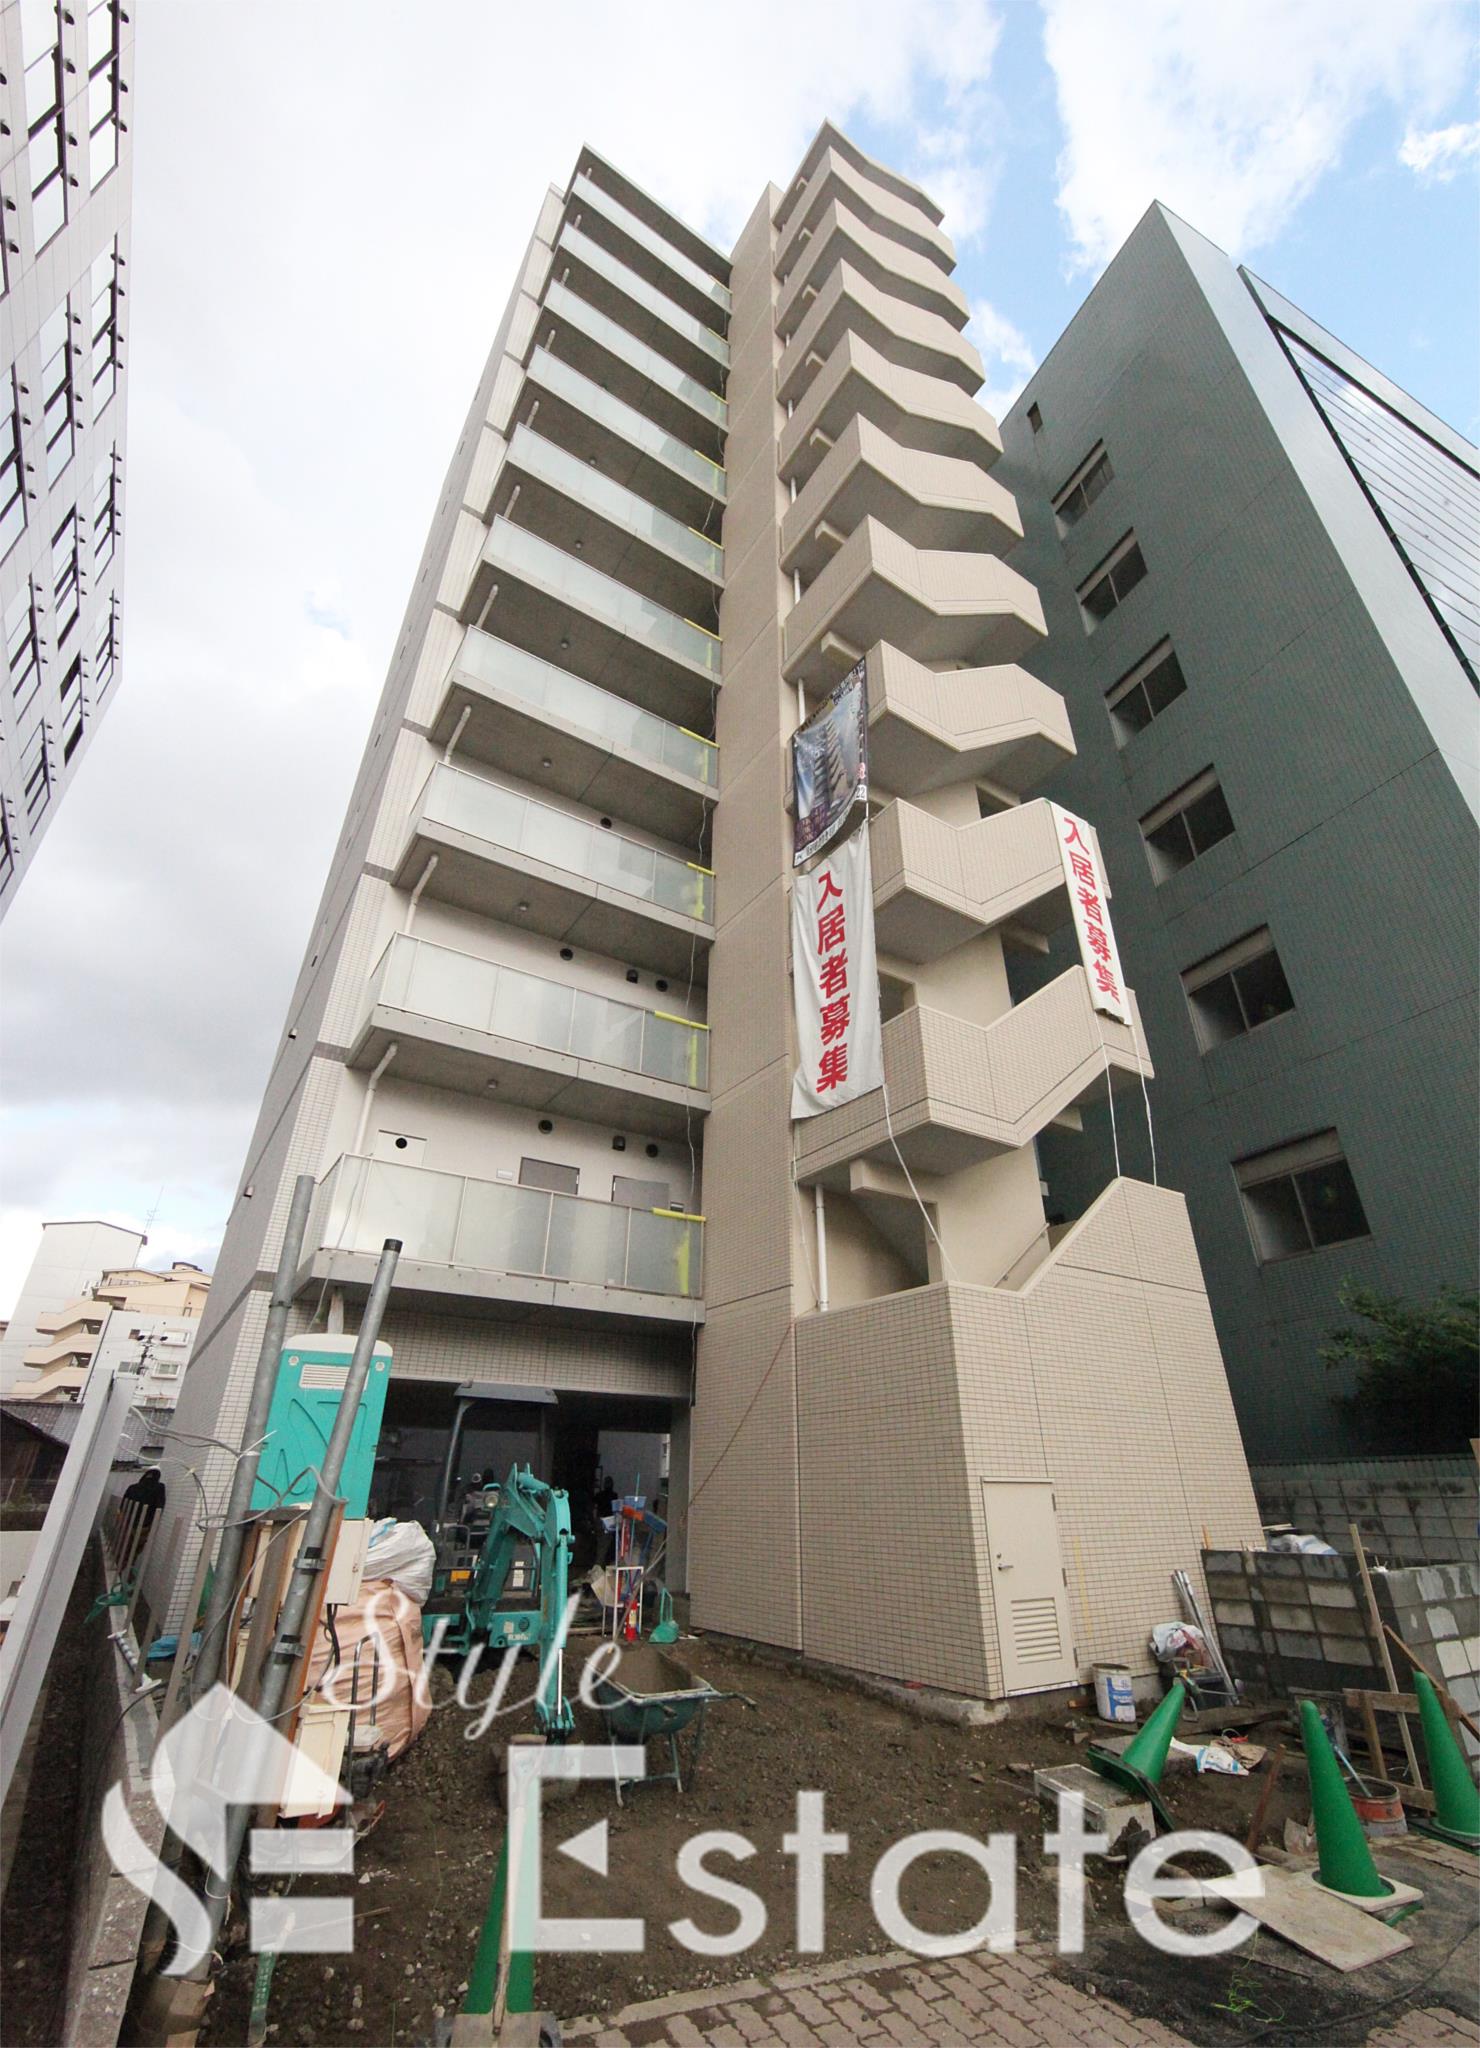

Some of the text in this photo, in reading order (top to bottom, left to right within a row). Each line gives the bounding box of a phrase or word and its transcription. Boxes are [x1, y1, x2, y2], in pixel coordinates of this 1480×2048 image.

[815, 870, 849, 1095] 入居者募集
[1065, 818, 1119, 1003] 入居者募集
